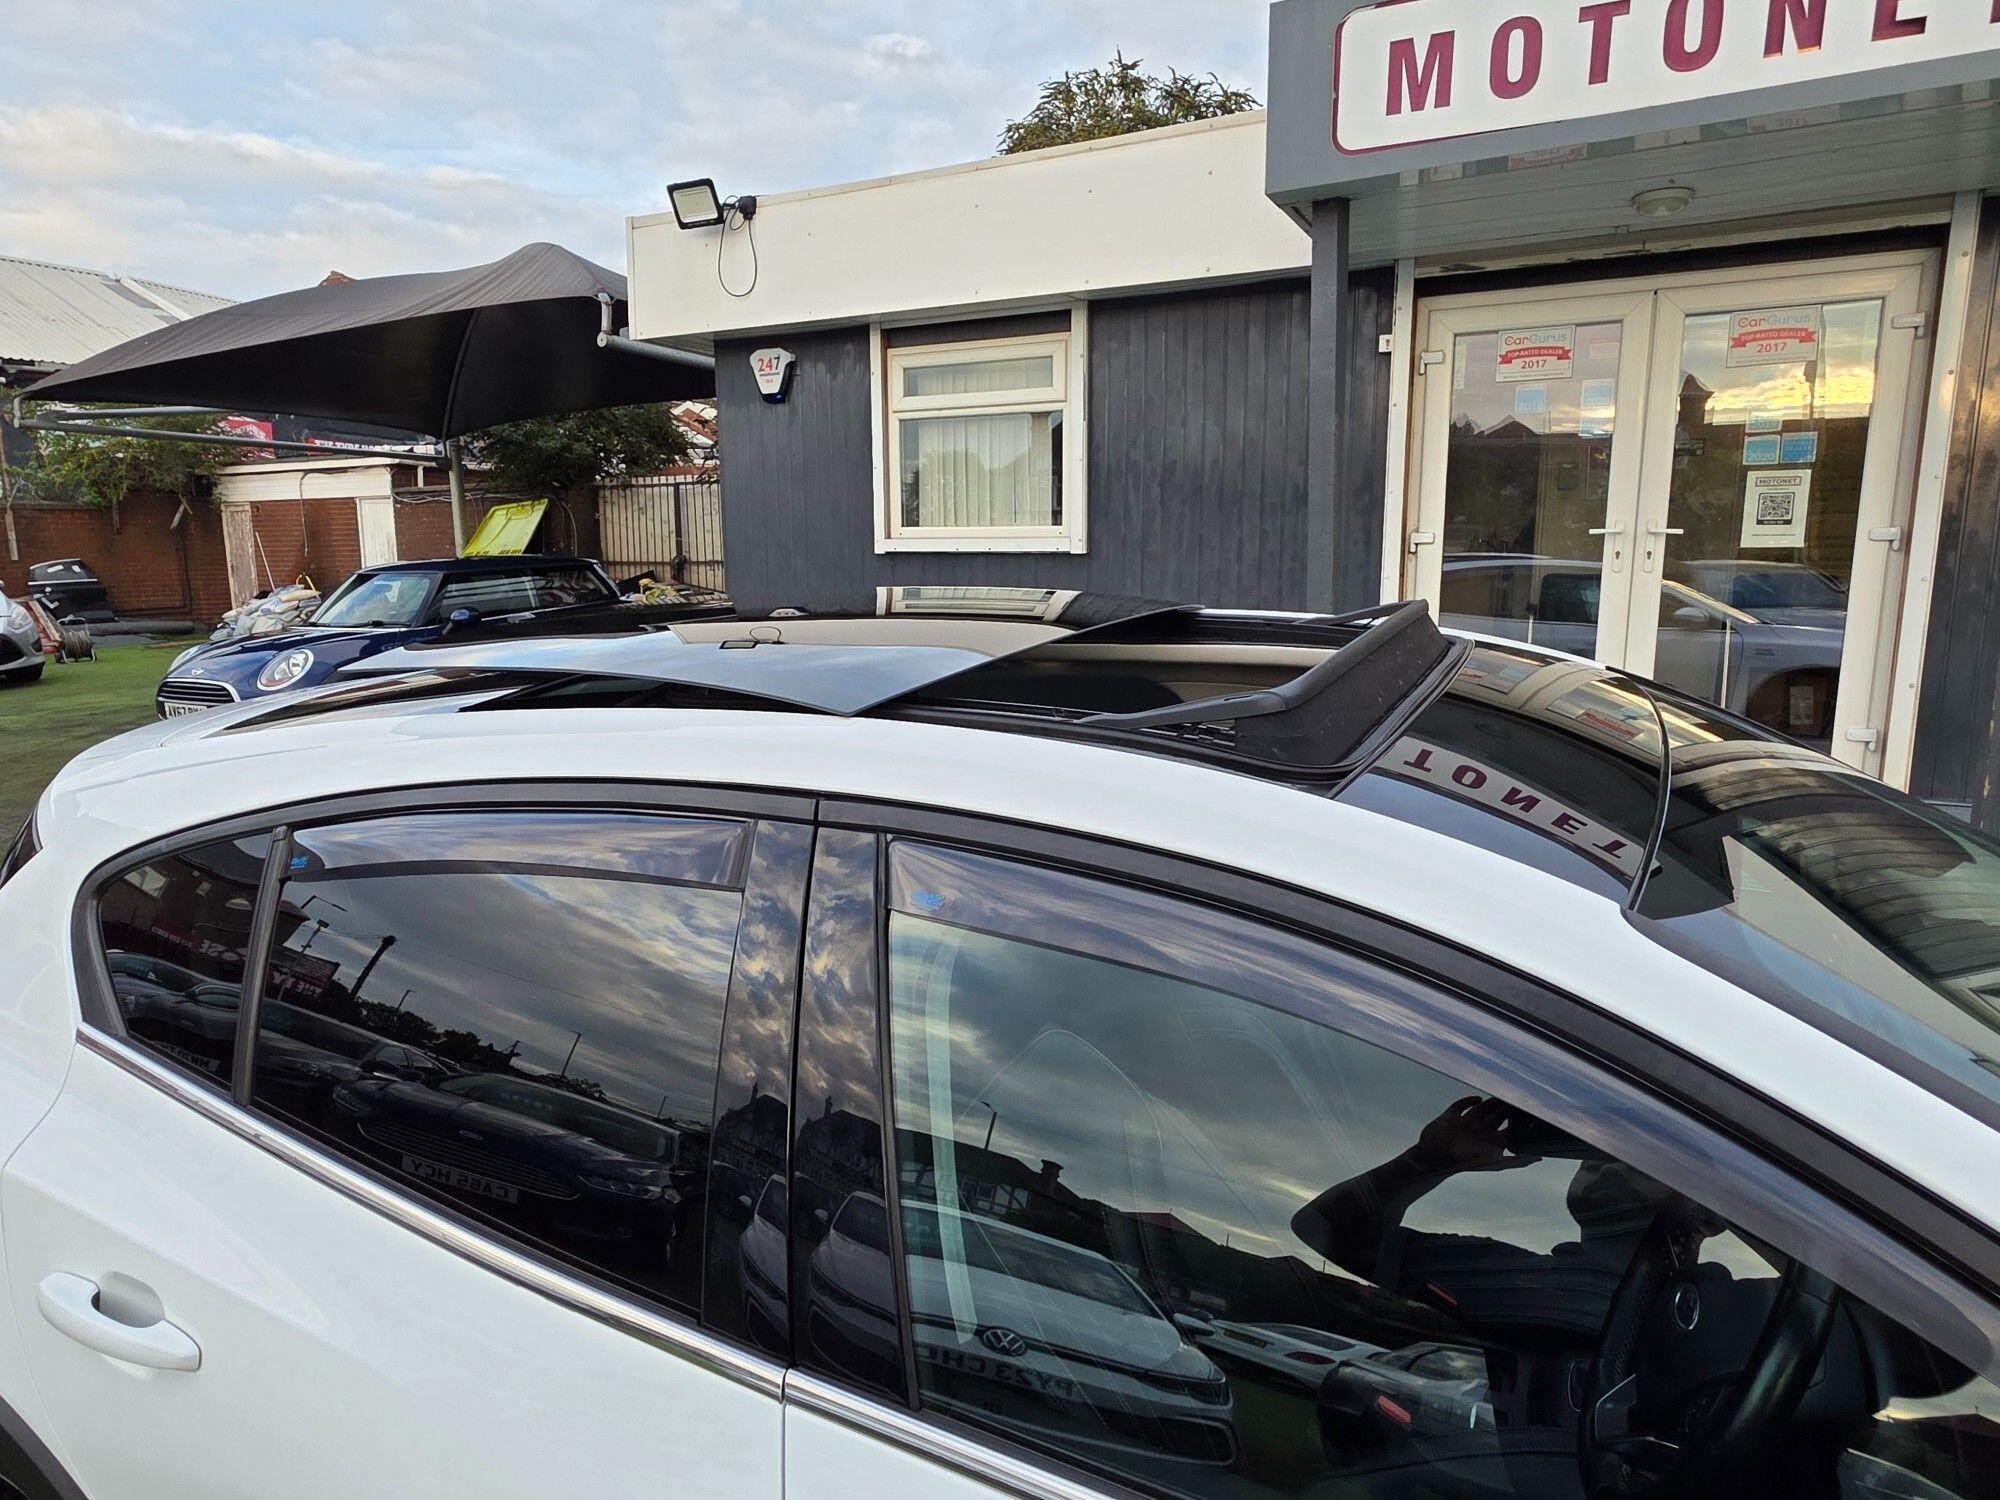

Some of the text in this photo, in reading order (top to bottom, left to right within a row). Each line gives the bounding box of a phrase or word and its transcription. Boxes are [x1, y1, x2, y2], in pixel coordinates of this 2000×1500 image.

[1386, 0, 2000, 116] MOTONE
[1738, 314, 1811, 328] CarGurus
[1505, 333, 1567, 346] CarGurus
[1741, 331, 1778, 340] TOP-RATED
[1508, 349, 1539, 358] TOP-RATED
[1757, 342, 1787, 353] 2017
[757, 354, 781, 372] 247
[1521, 359, 1547, 369] 2017
